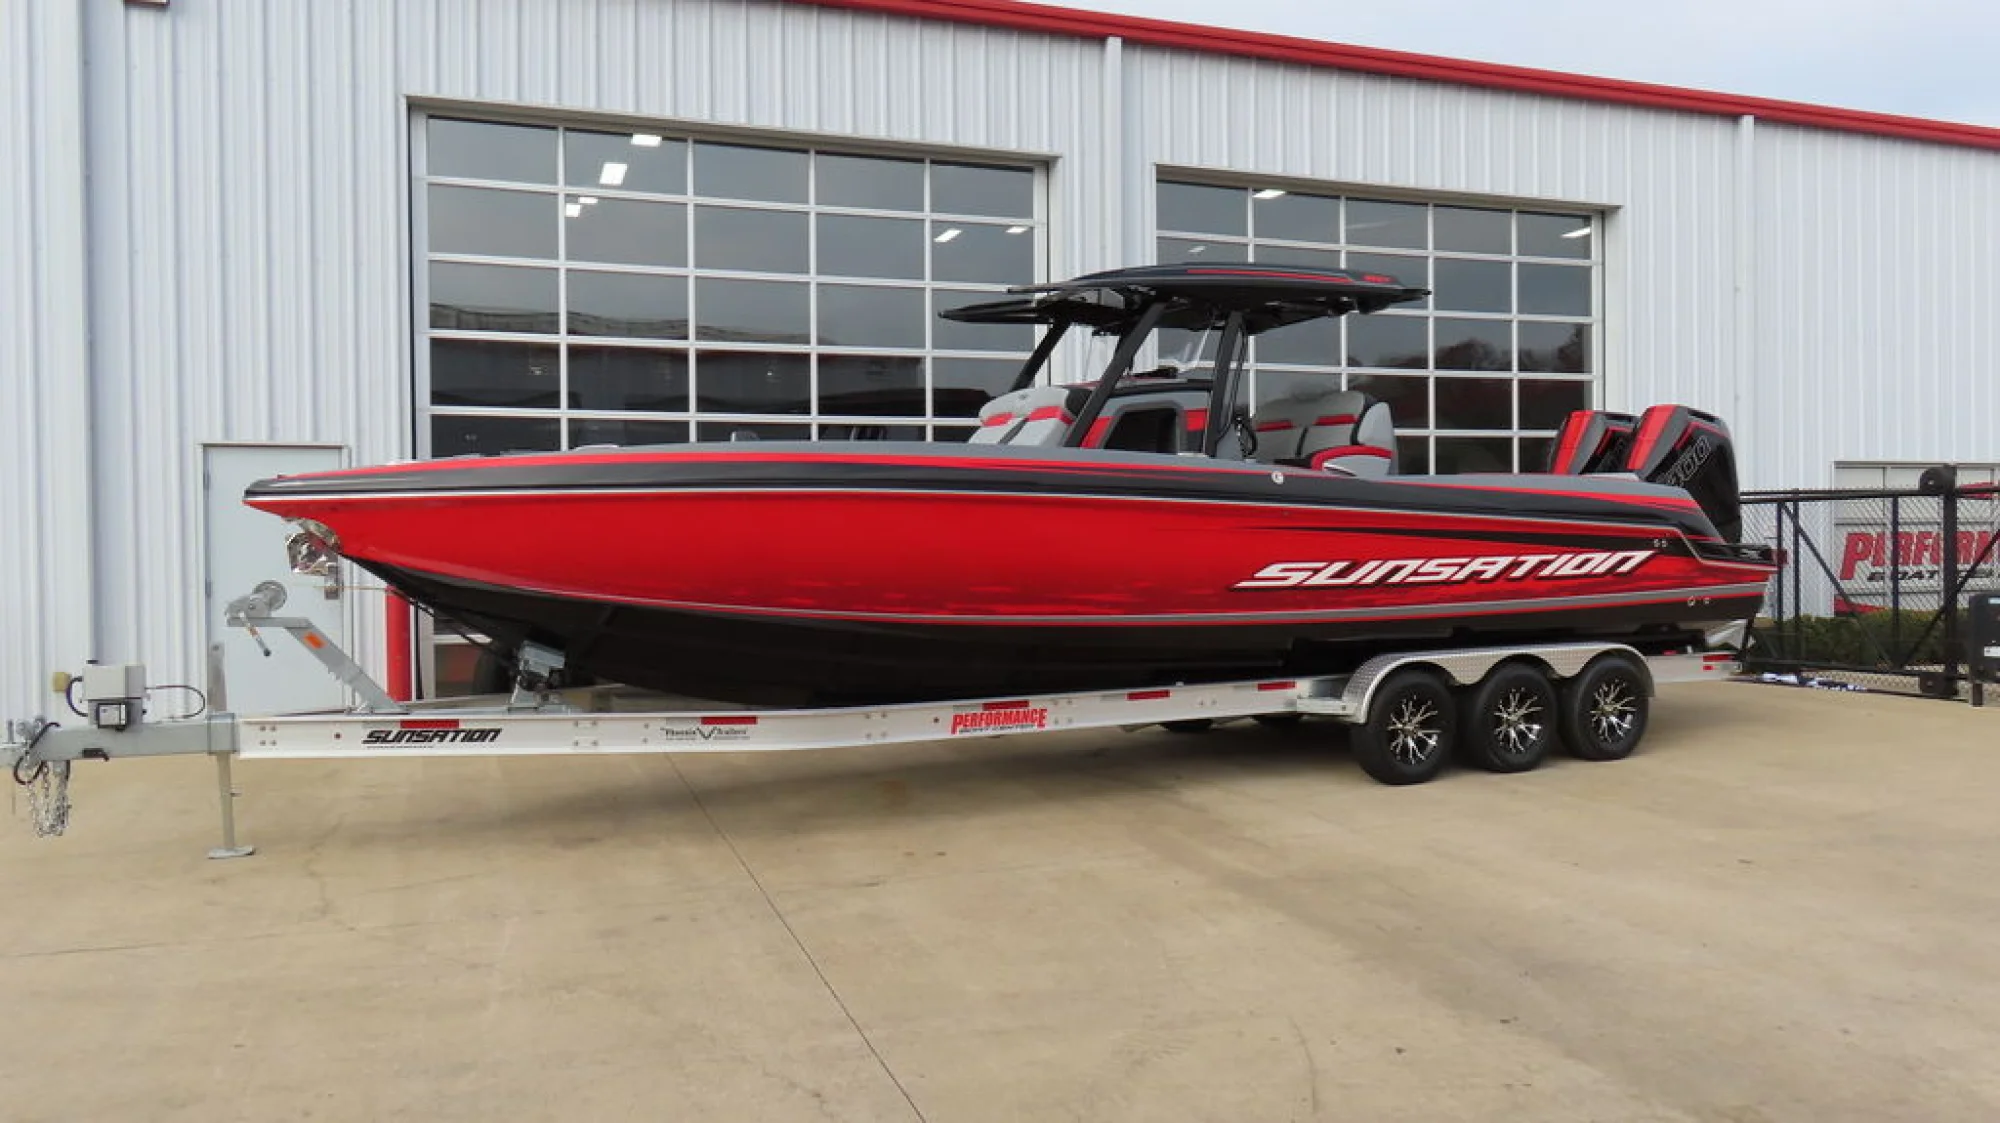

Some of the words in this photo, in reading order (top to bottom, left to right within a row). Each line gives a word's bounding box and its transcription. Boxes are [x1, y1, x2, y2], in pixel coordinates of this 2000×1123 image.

[1233, 550, 1657, 589] SUNSATION
[951, 708, 1047, 735] PERFORMANCE
[362, 728, 502, 744] SUNSATION
